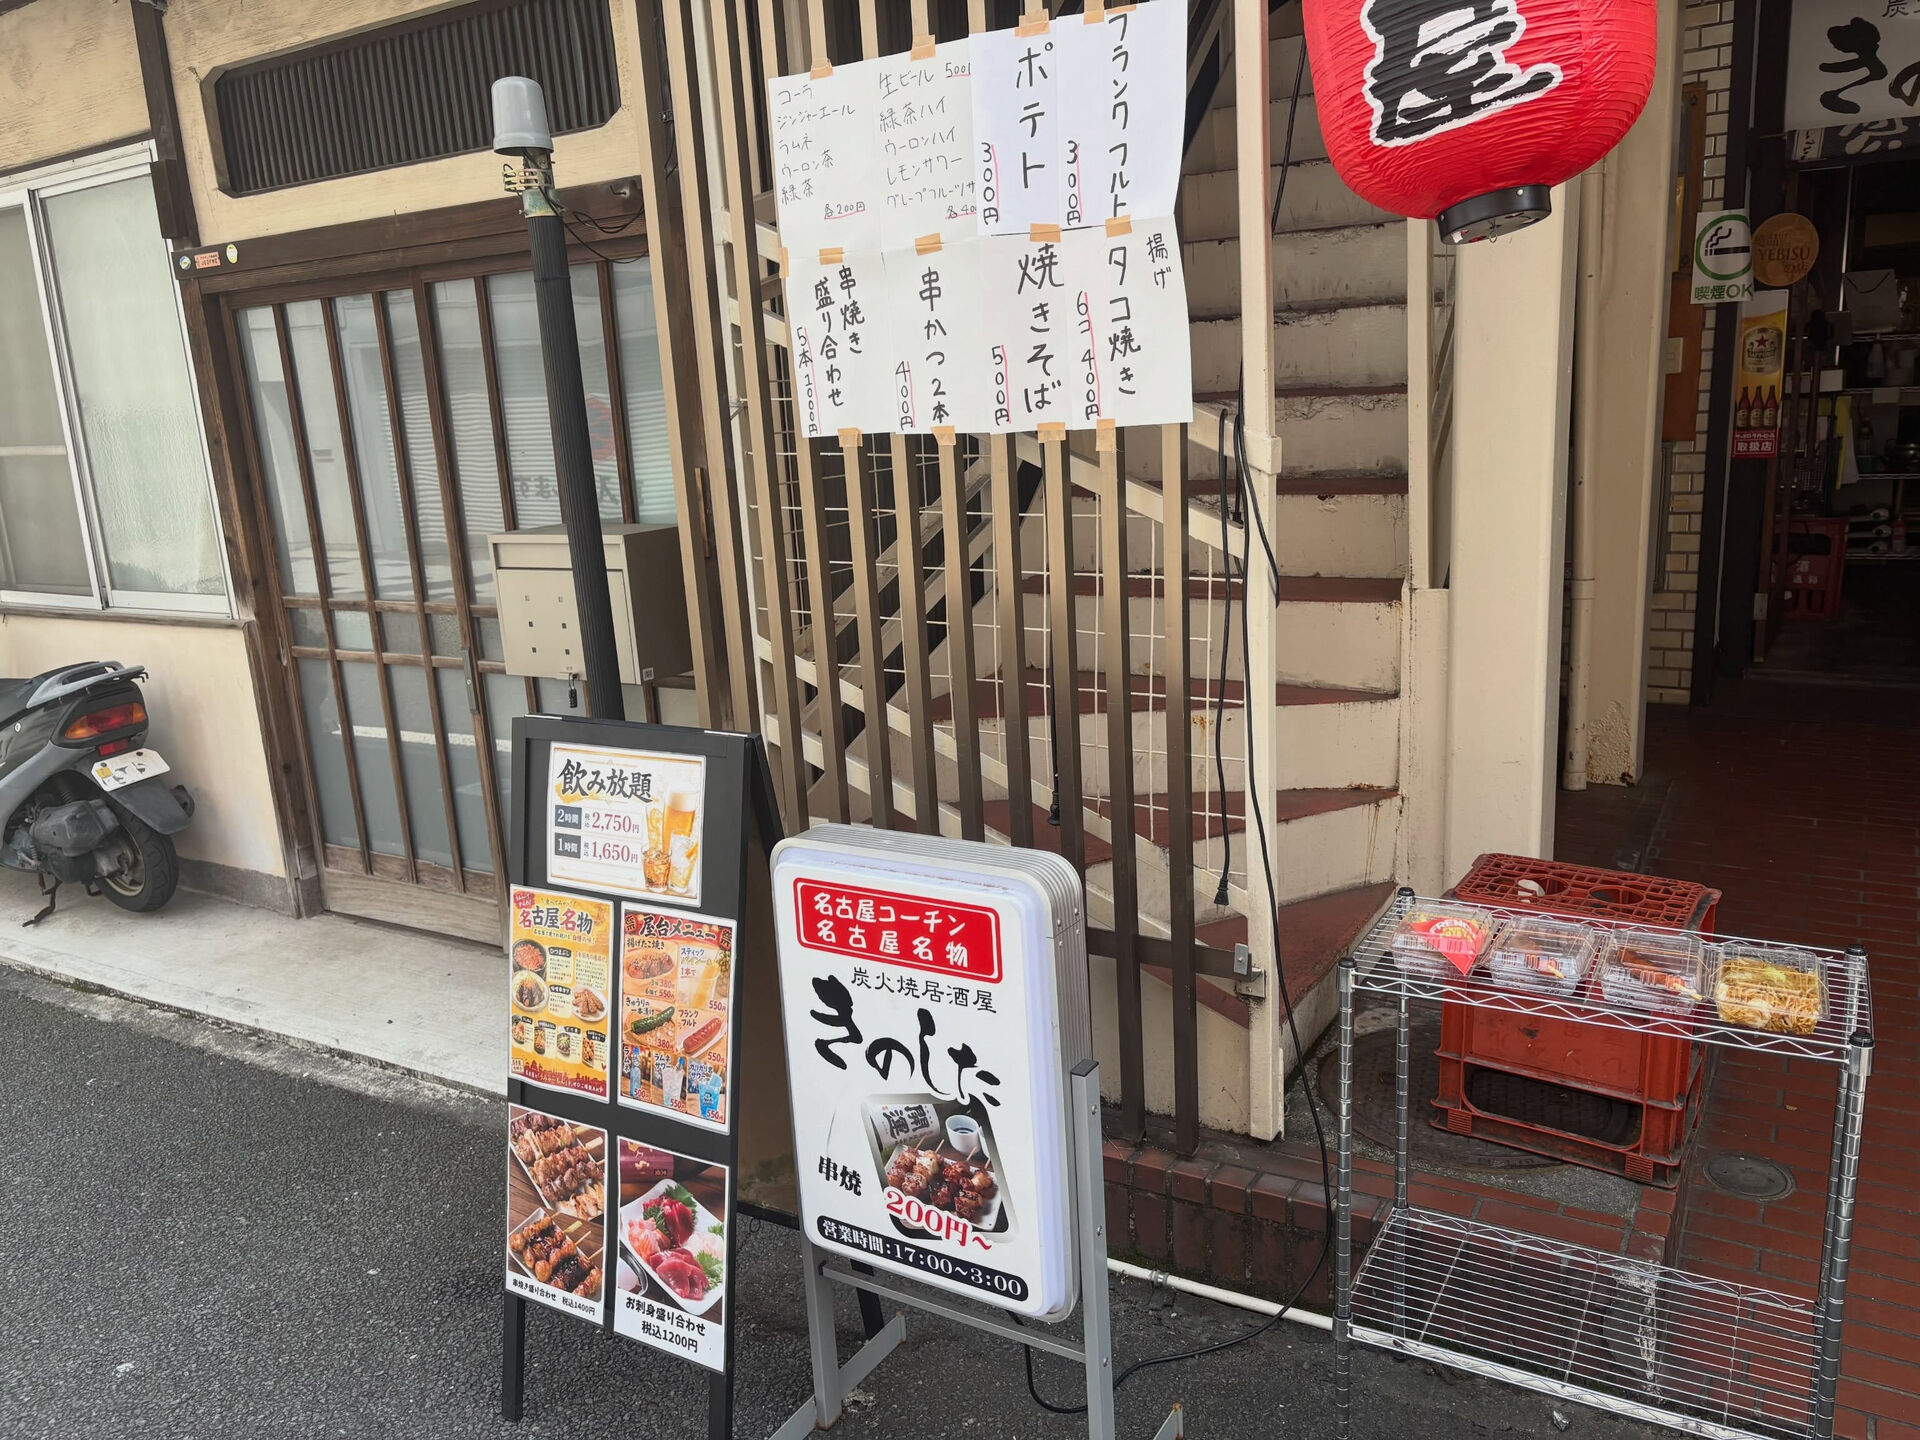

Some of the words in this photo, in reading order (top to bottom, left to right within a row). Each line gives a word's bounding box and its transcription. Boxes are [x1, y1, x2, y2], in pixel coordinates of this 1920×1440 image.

[778, 84, 813, 106] コーラ
[879, 69, 934, 99] 生ビール
[945, 62, 971, 78] 500
[777, 104, 856, 130] ジンジャーエール
[879, 95, 946, 133] 緑茶ハイ
[1015, 41, 1054, 190] ポテト
[1107, 13, 1130, 219] フランクフルト
[778, 133, 813, 155] ラムネ
[884, 125, 956, 156] ウーロンハイ
[781, 149, 834, 178] ウーロン茶
[886, 154, 963, 186] レモンサワー
[781, 178, 814, 206] 緑茶
[981, 142, 999, 226] 300円
[1065, 140, 1082, 225] 300円
[823, 201, 866, 219] 各200円
[946, 204, 977, 219] 各40
[1146, 232, 1173, 290] 揚げ
[1758, 246, 1811, 261] YEBISU
[1694, 283, 1754, 300] 喫煙OK
[837, 264, 866, 355] 串焼き
[1108, 245, 1142, 396] タコ焼き
[813, 278, 845, 407] 盛り合わせ
[1017, 243, 1064, 414] 焼きそば
[918, 265, 950, 424] 串かつ2本
[895, 360, 915, 430] 400円
[991, 345, 1011, 424] 500円
[1081, 347, 1101, 419] 400円
[1736, 441, 1773, 452] 取扱店
[556, 758, 654, 804] 飲み放題
[557, 808, 580, 825] 2時間
[591, 811, 640, 834] 2,750円
[556, 837, 579, 854] 1時間
[591, 840, 639, 864] 1,650円
[519, 904, 593, 935] 名古屋名物
[639, 914, 717, 940] 屋台メニュー
[813, 891, 966, 936] 名古屋コーチン
[626, 937, 665, 950] 揚げたこ焼き
[680, 947, 705, 957] スティック
[816, 919, 969, 968] 名古屋名物
[681, 967, 697, 977] 1本で
[625, 997, 650, 1007] きゅうりの
[850, 966, 997, 1014] 炭火焼居酒屋
[677, 1009, 699, 1018] フランク
[708, 999, 727, 1013] 550円
[681, 1018, 697, 1027] フルト
[657, 1038, 674, 1050] 380円
[809, 974, 1001, 1107] きのした
[654, 1053, 671, 1062] ラムネ
[654, 1062, 671, 1071] サワー
[707, 1051, 725, 1064] 550円
[705, 1108, 724, 1121] 550円
[818, 1155, 862, 1197] 串焼
[512, 1278, 557, 1302] 串焼き盛り合わせ
[562, 1296, 596, 1317] 税込1400円
[625, 1296, 706, 1337] お刺身盛り合わせ
[641, 1320, 699, 1353] 税込1200円
